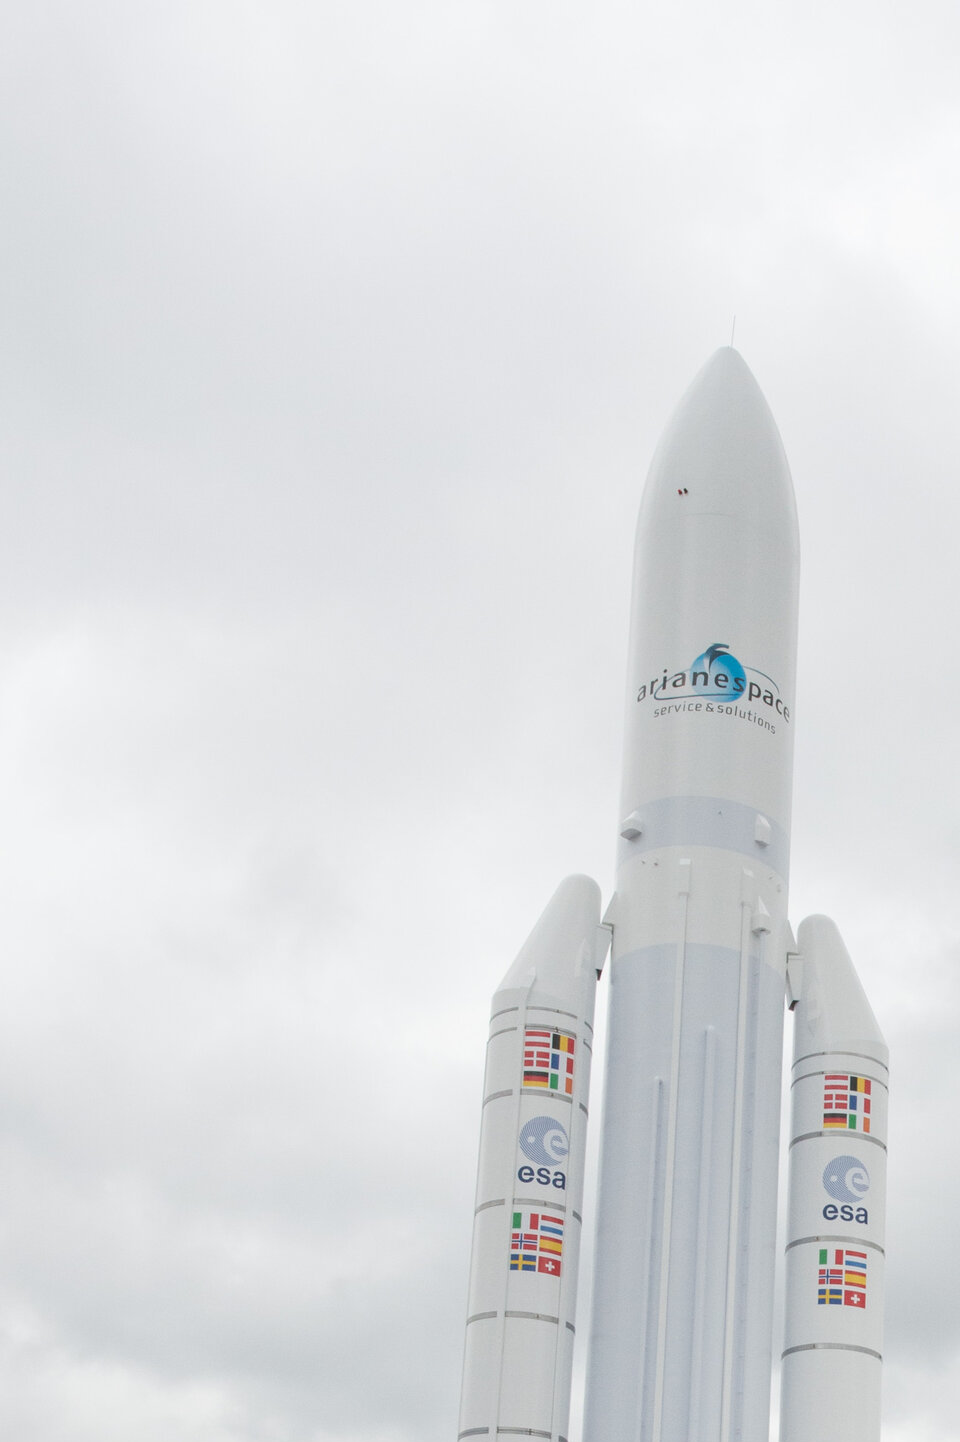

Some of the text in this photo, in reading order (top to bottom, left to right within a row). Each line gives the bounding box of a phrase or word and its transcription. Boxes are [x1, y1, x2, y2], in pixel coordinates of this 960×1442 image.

[637, 669, 790, 724] arianespace
[654, 701, 702, 718] service
[717, 705, 776, 735] solutions
[517, 1165, 566, 1190] esa
[822, 1204, 869, 1225] esa
